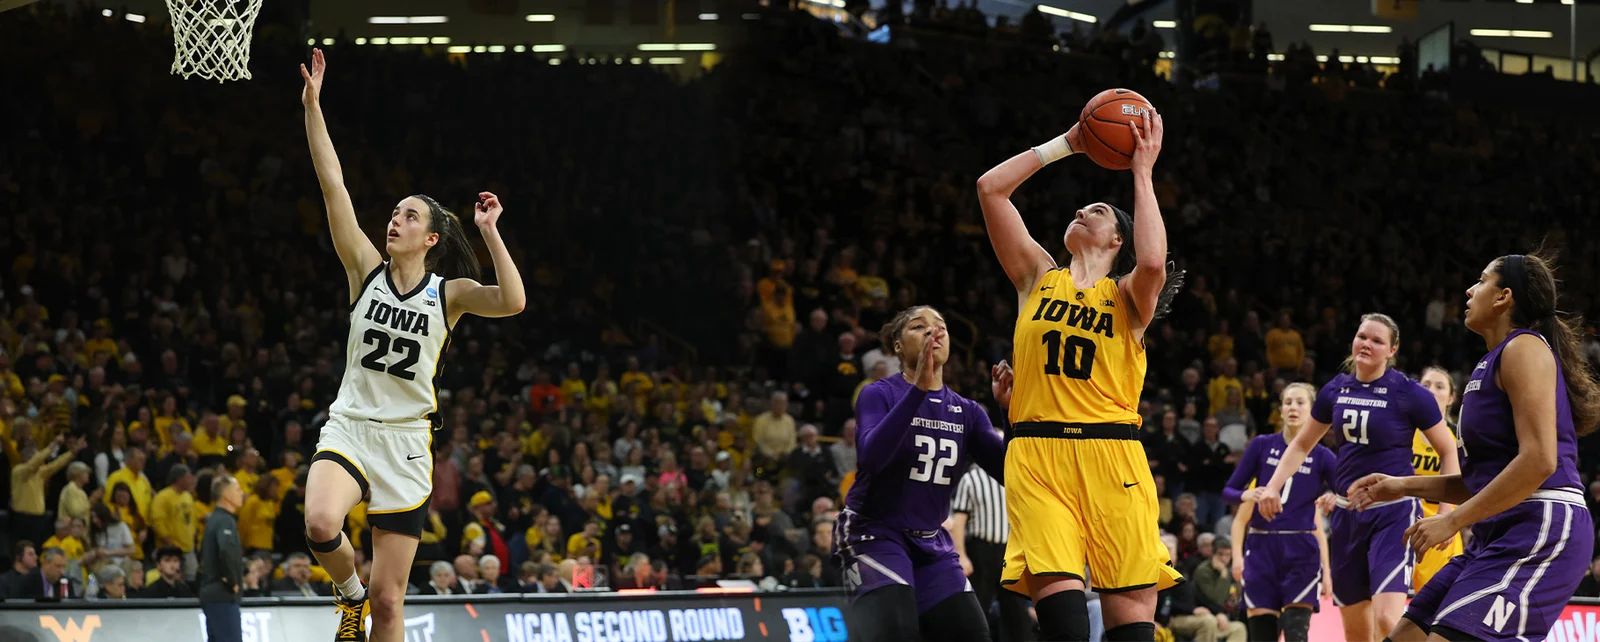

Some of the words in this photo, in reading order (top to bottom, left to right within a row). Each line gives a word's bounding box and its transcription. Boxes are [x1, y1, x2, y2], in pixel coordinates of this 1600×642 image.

[364, 299, 429, 337] IOWA
[1032, 298, 1114, 338] IOWA
[361, 328, 421, 381] 22
[1042, 330, 1096, 381] 10
[1342, 409, 1370, 445] 21
[909, 434, 958, 486] 32
[1410, 453, 1441, 472] OW
[505, 613, 573, 642] NCAA
[574, 610, 668, 642] SECOND
[668, 607, 745, 642] ROUND
[1482, 594, 1516, 633] N
